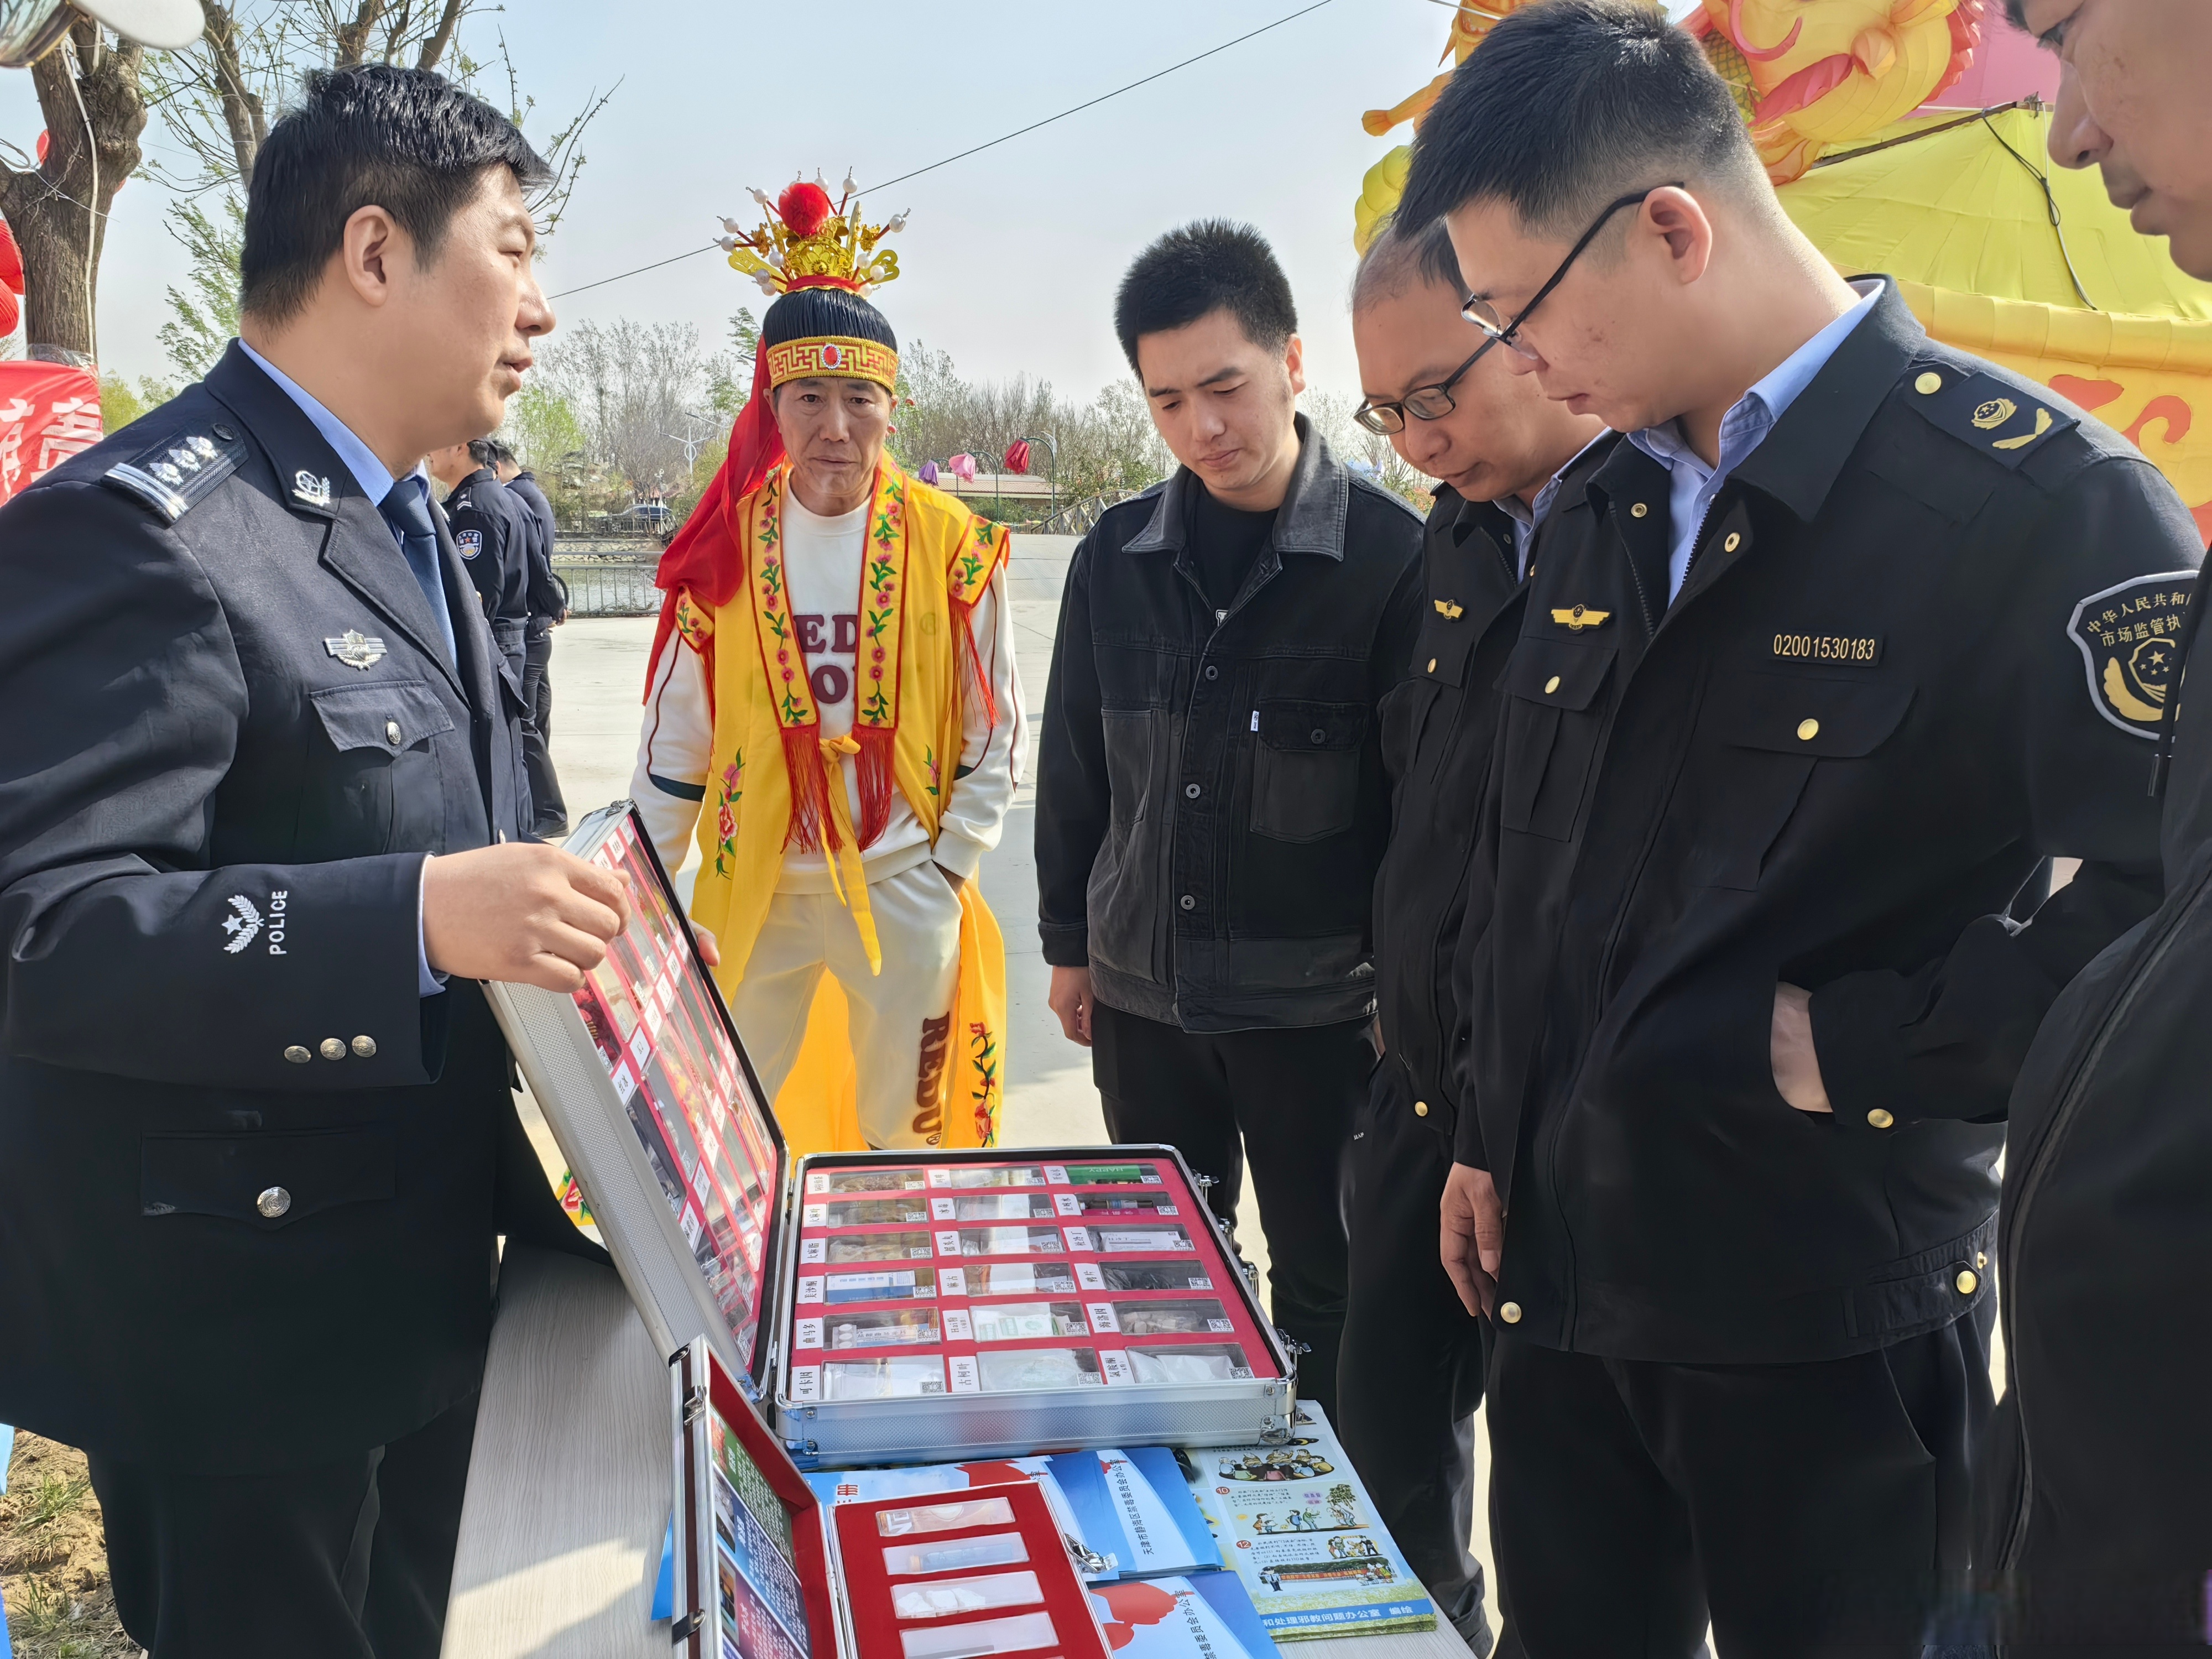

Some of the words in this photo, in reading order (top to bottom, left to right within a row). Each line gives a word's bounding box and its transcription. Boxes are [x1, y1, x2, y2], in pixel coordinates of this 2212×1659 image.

[2087, 591, 2191, 633] 中华人民共和
[2100, 612, 2186, 647] 市场监管执
[1773, 634, 1875, 660] 02001530183
[811, 665, 855, 704] O
[269, 890, 288, 955] POLICE
[810, 1208, 820, 1223] 大麻叶
[942, 1235, 956, 1251] 摇头丸
[1071, 1232, 1086, 1246] 杜冷丁
[946, 1276, 959, 1288] 麻古
[1084, 1270, 1098, 1282] 鸦片
[804, 1281, 817, 1298] 美沙酮
[947, 1317, 959, 1333] Hai粉
[1094, 1308, 1112, 1328] 海洛因
[803, 1324, 816, 1344] 曲马多
[957, 1363, 971, 1385] 古柯叶
[1105, 1357, 1121, 1377] 氯胺酮
[799, 1371, 813, 1394] 可卡因
[1109, 1458, 1154, 1556] 天津市静海区禁毒委员会办公室
[1262, 1608, 1381, 1627] 和处理邪教问题办公室
[1389, 1605, 1413, 1616] 编绘
